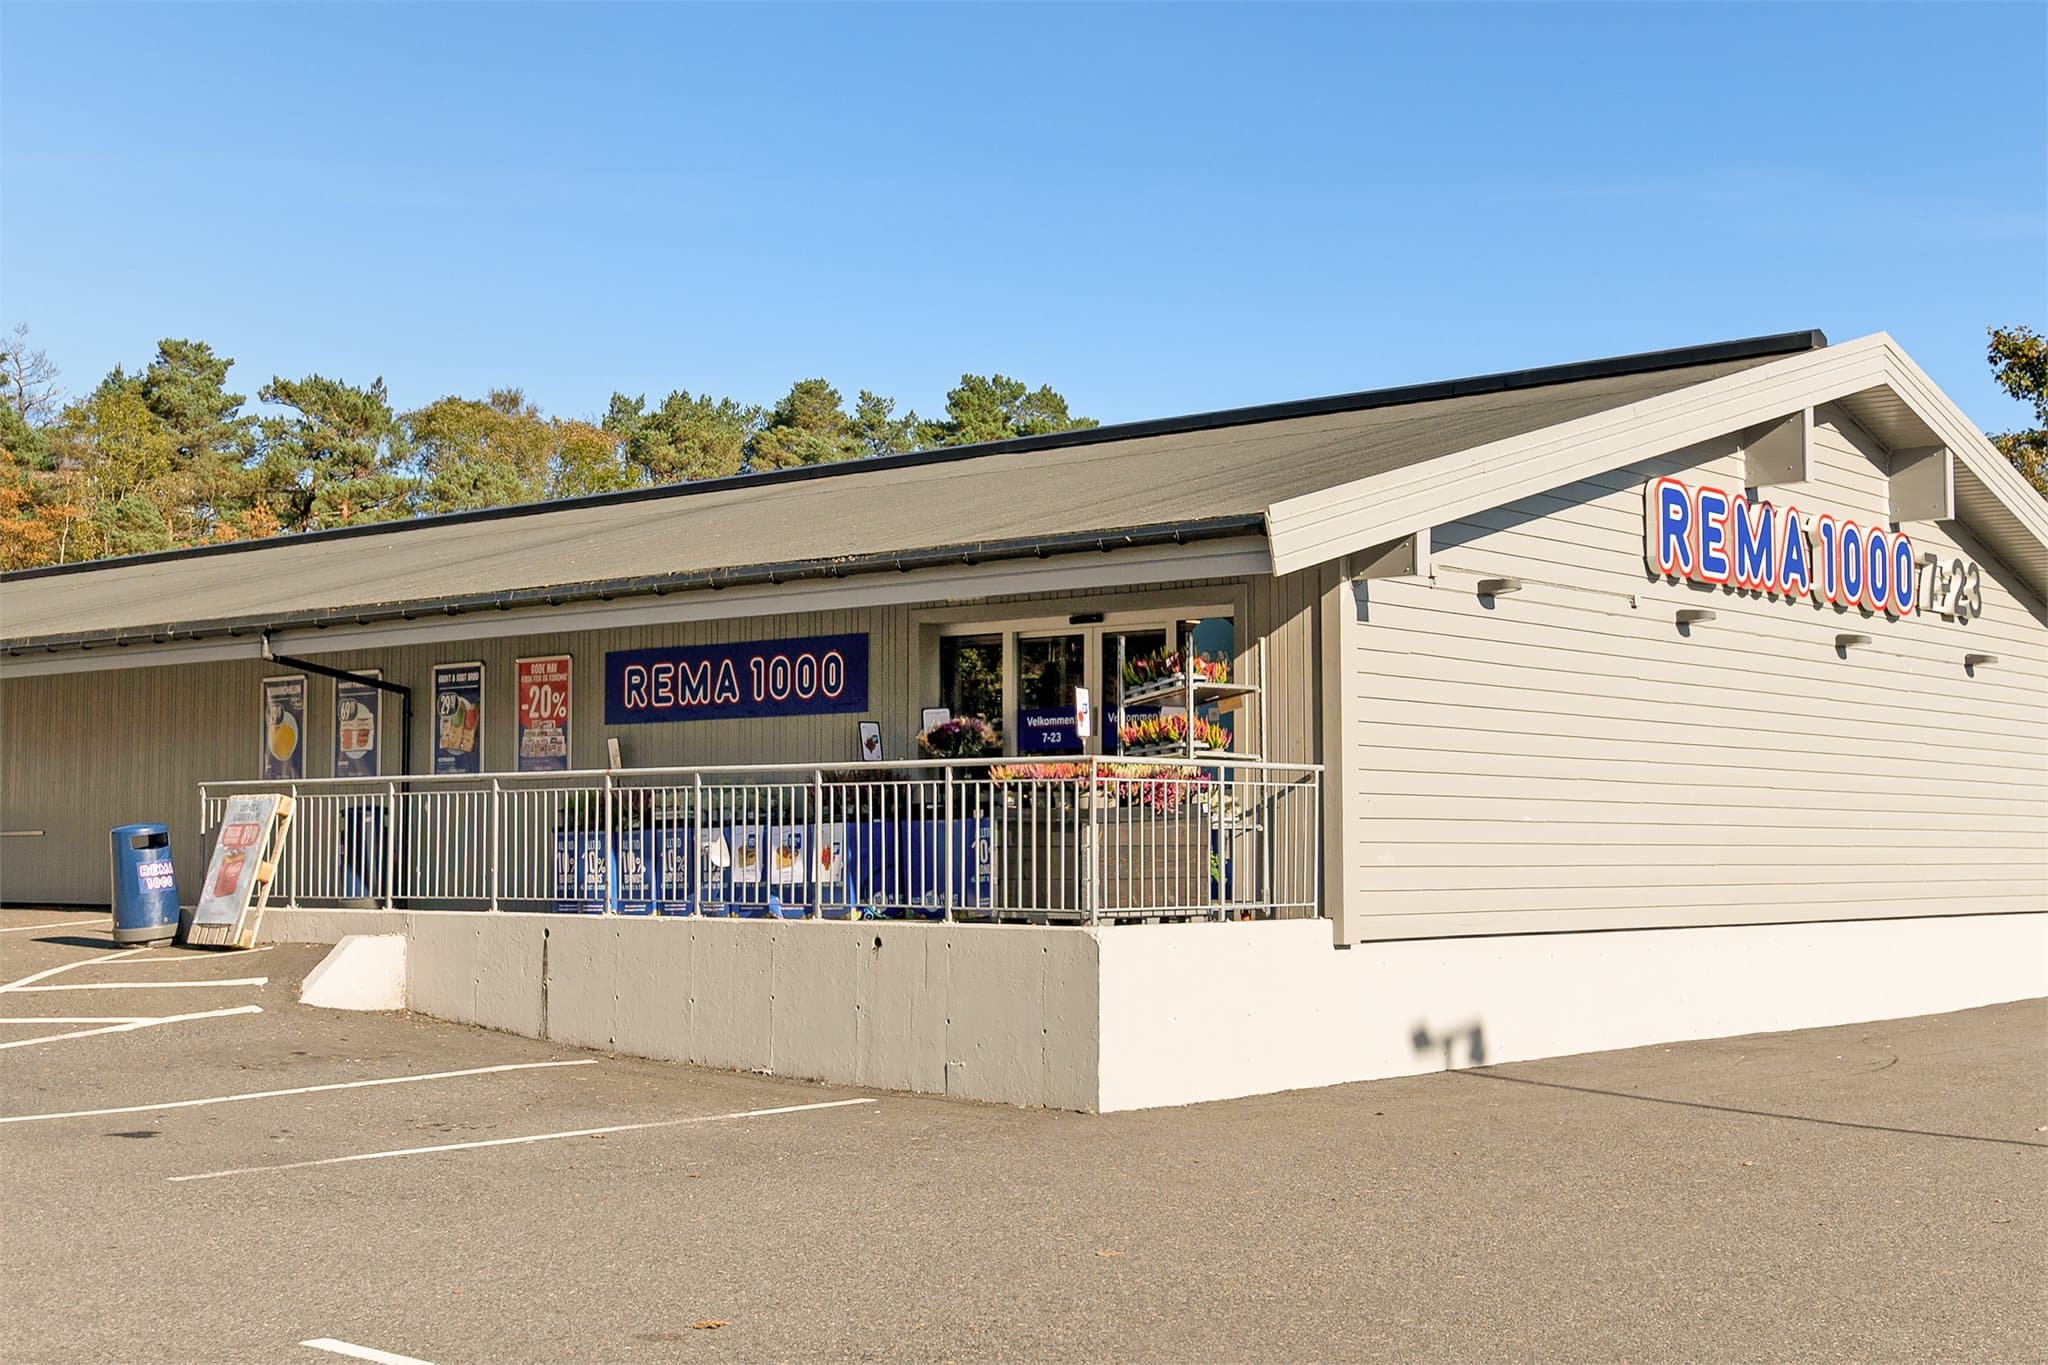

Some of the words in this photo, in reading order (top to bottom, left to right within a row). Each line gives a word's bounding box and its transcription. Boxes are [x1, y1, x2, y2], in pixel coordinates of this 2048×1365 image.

[1655, 477, 1811, 598] REMA
[1818, 513, 1916, 616] 1000
[1917, 552, 1983, 620] 7-23
[623, 658, 740, 709] REMA
[750, 650, 845, 702] 1000
[521, 683, 567, 719] -20%
[1026, 716, 1075, 727] Velkommen
[1107, 713, 1158, 723] Veommen
[1042, 732, 1062, 743] 7-23
